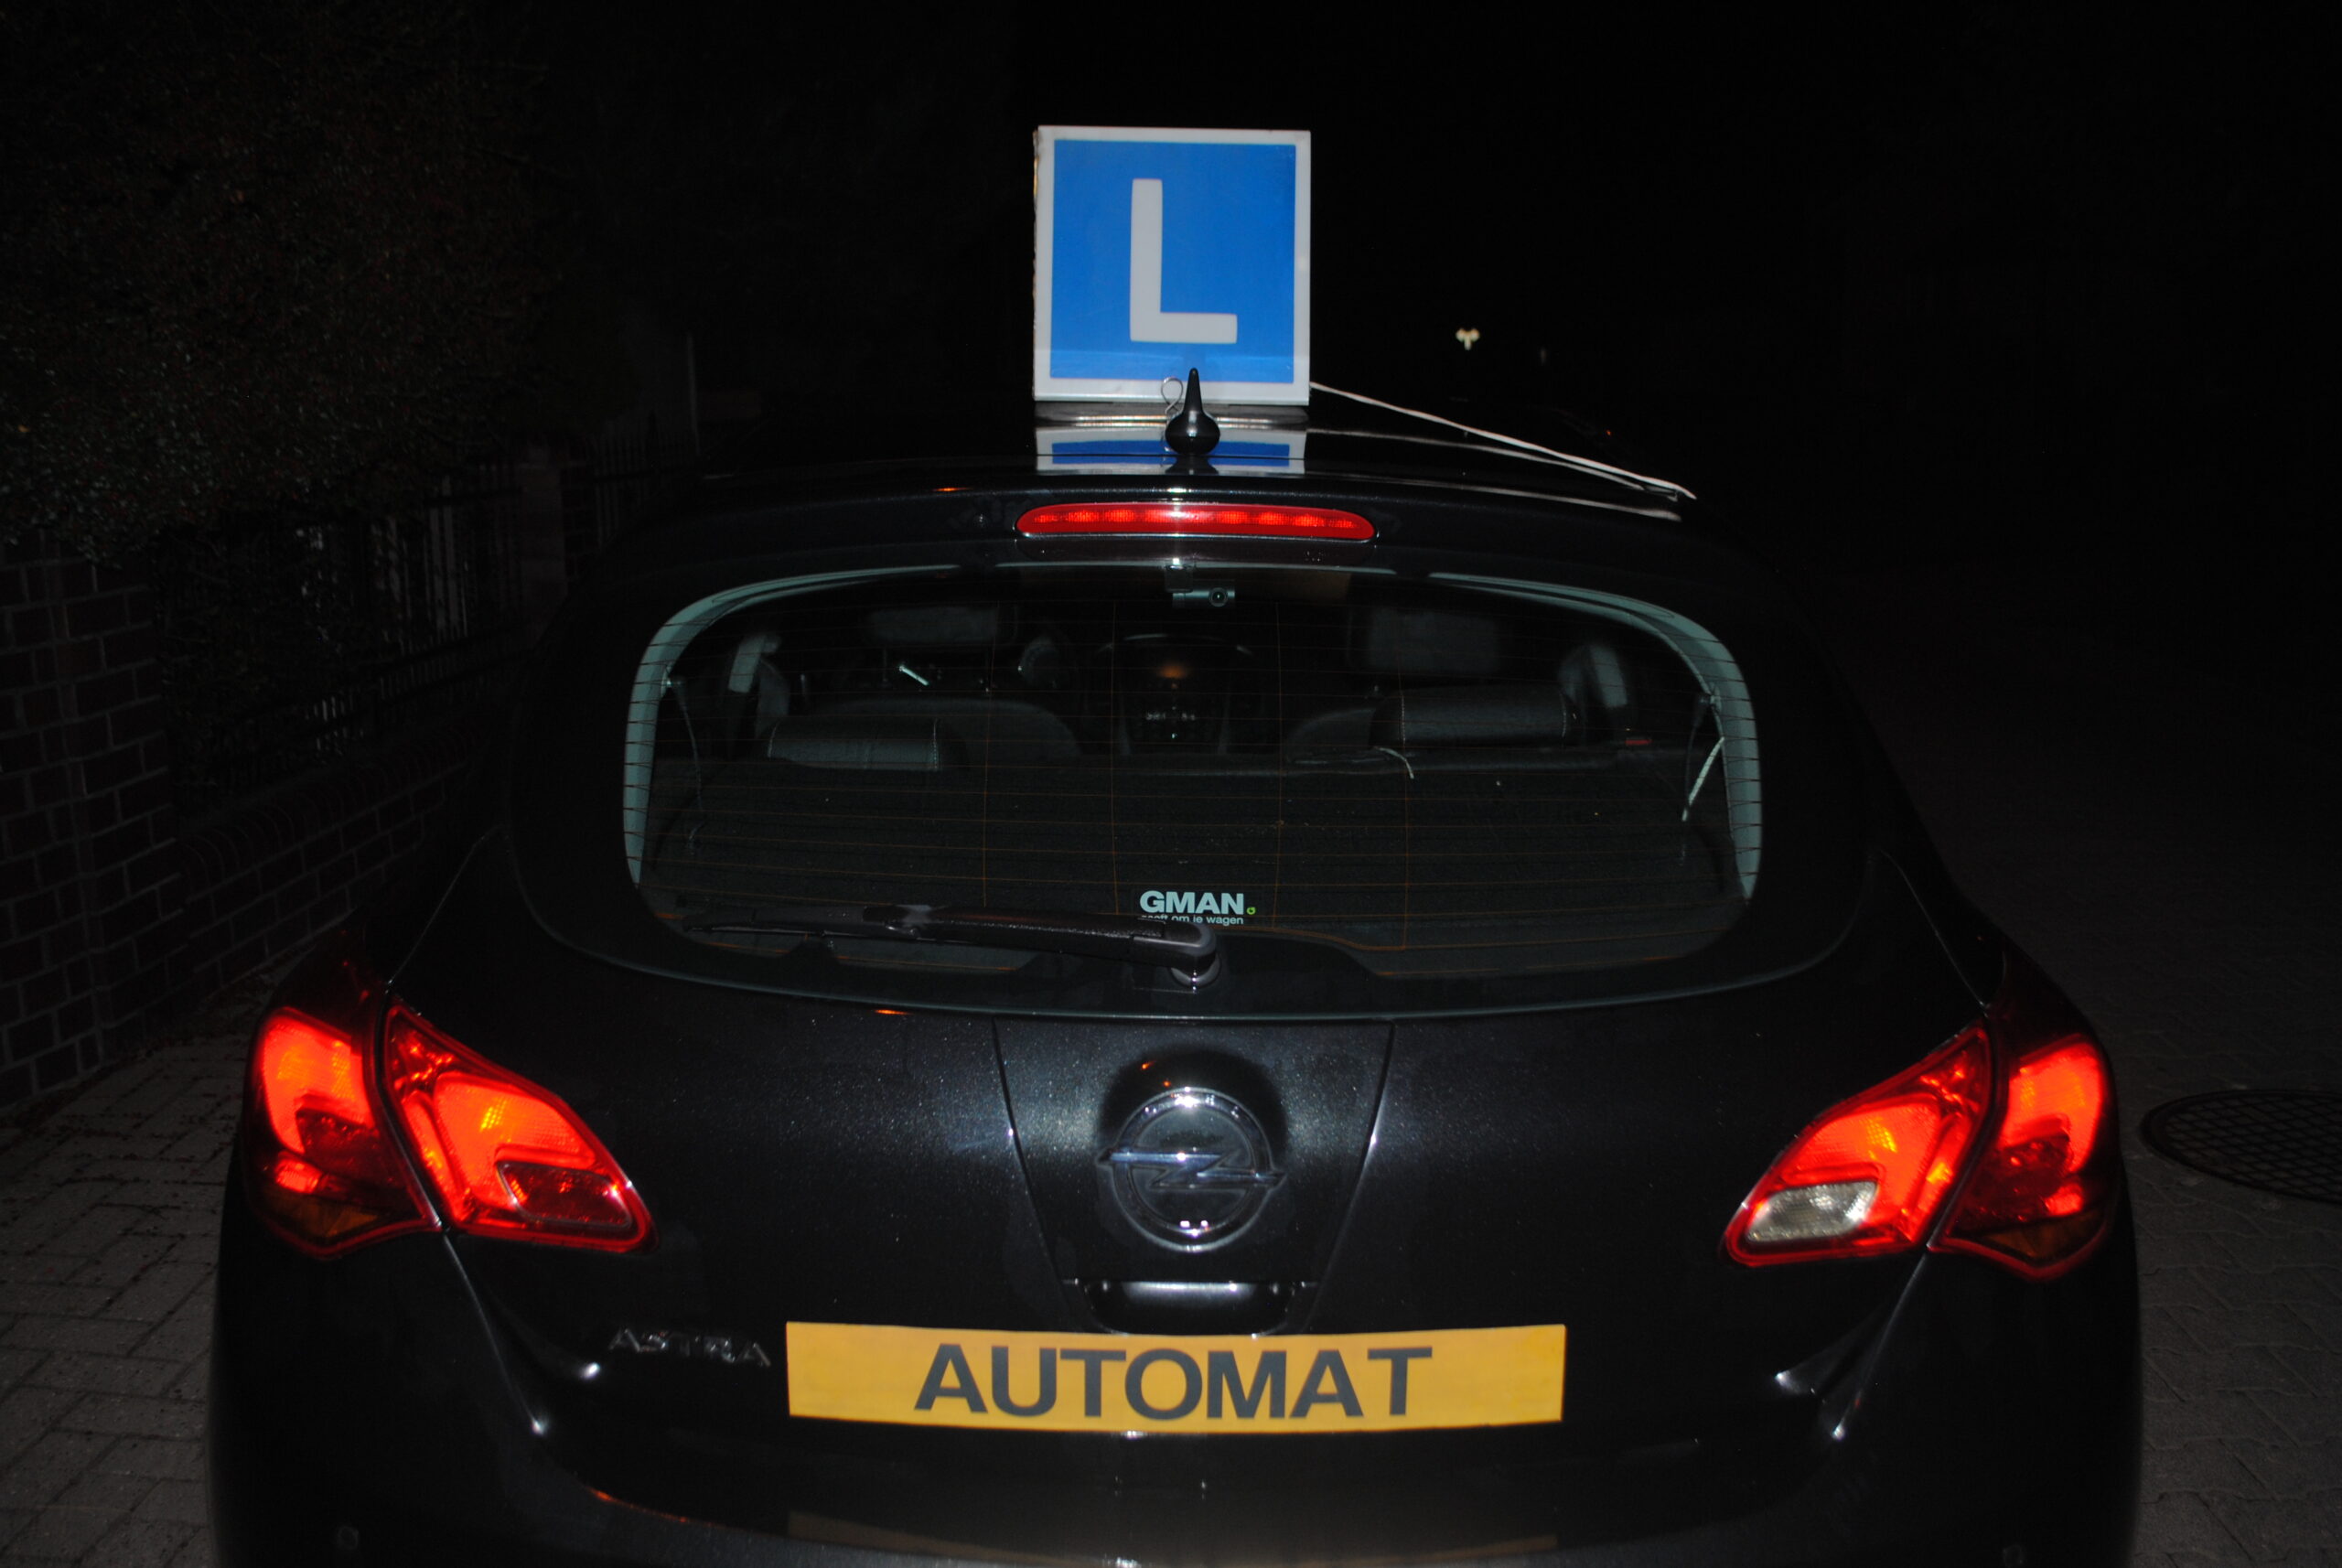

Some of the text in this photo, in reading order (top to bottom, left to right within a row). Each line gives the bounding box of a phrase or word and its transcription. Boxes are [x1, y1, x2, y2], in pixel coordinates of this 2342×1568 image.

[1130, 178, 1238, 344] L
[1207, 917, 1243, 927] wagen
[608, 1328, 771, 1367] ASTRA
[915, 1343, 1433, 1420] AUTOMAT
